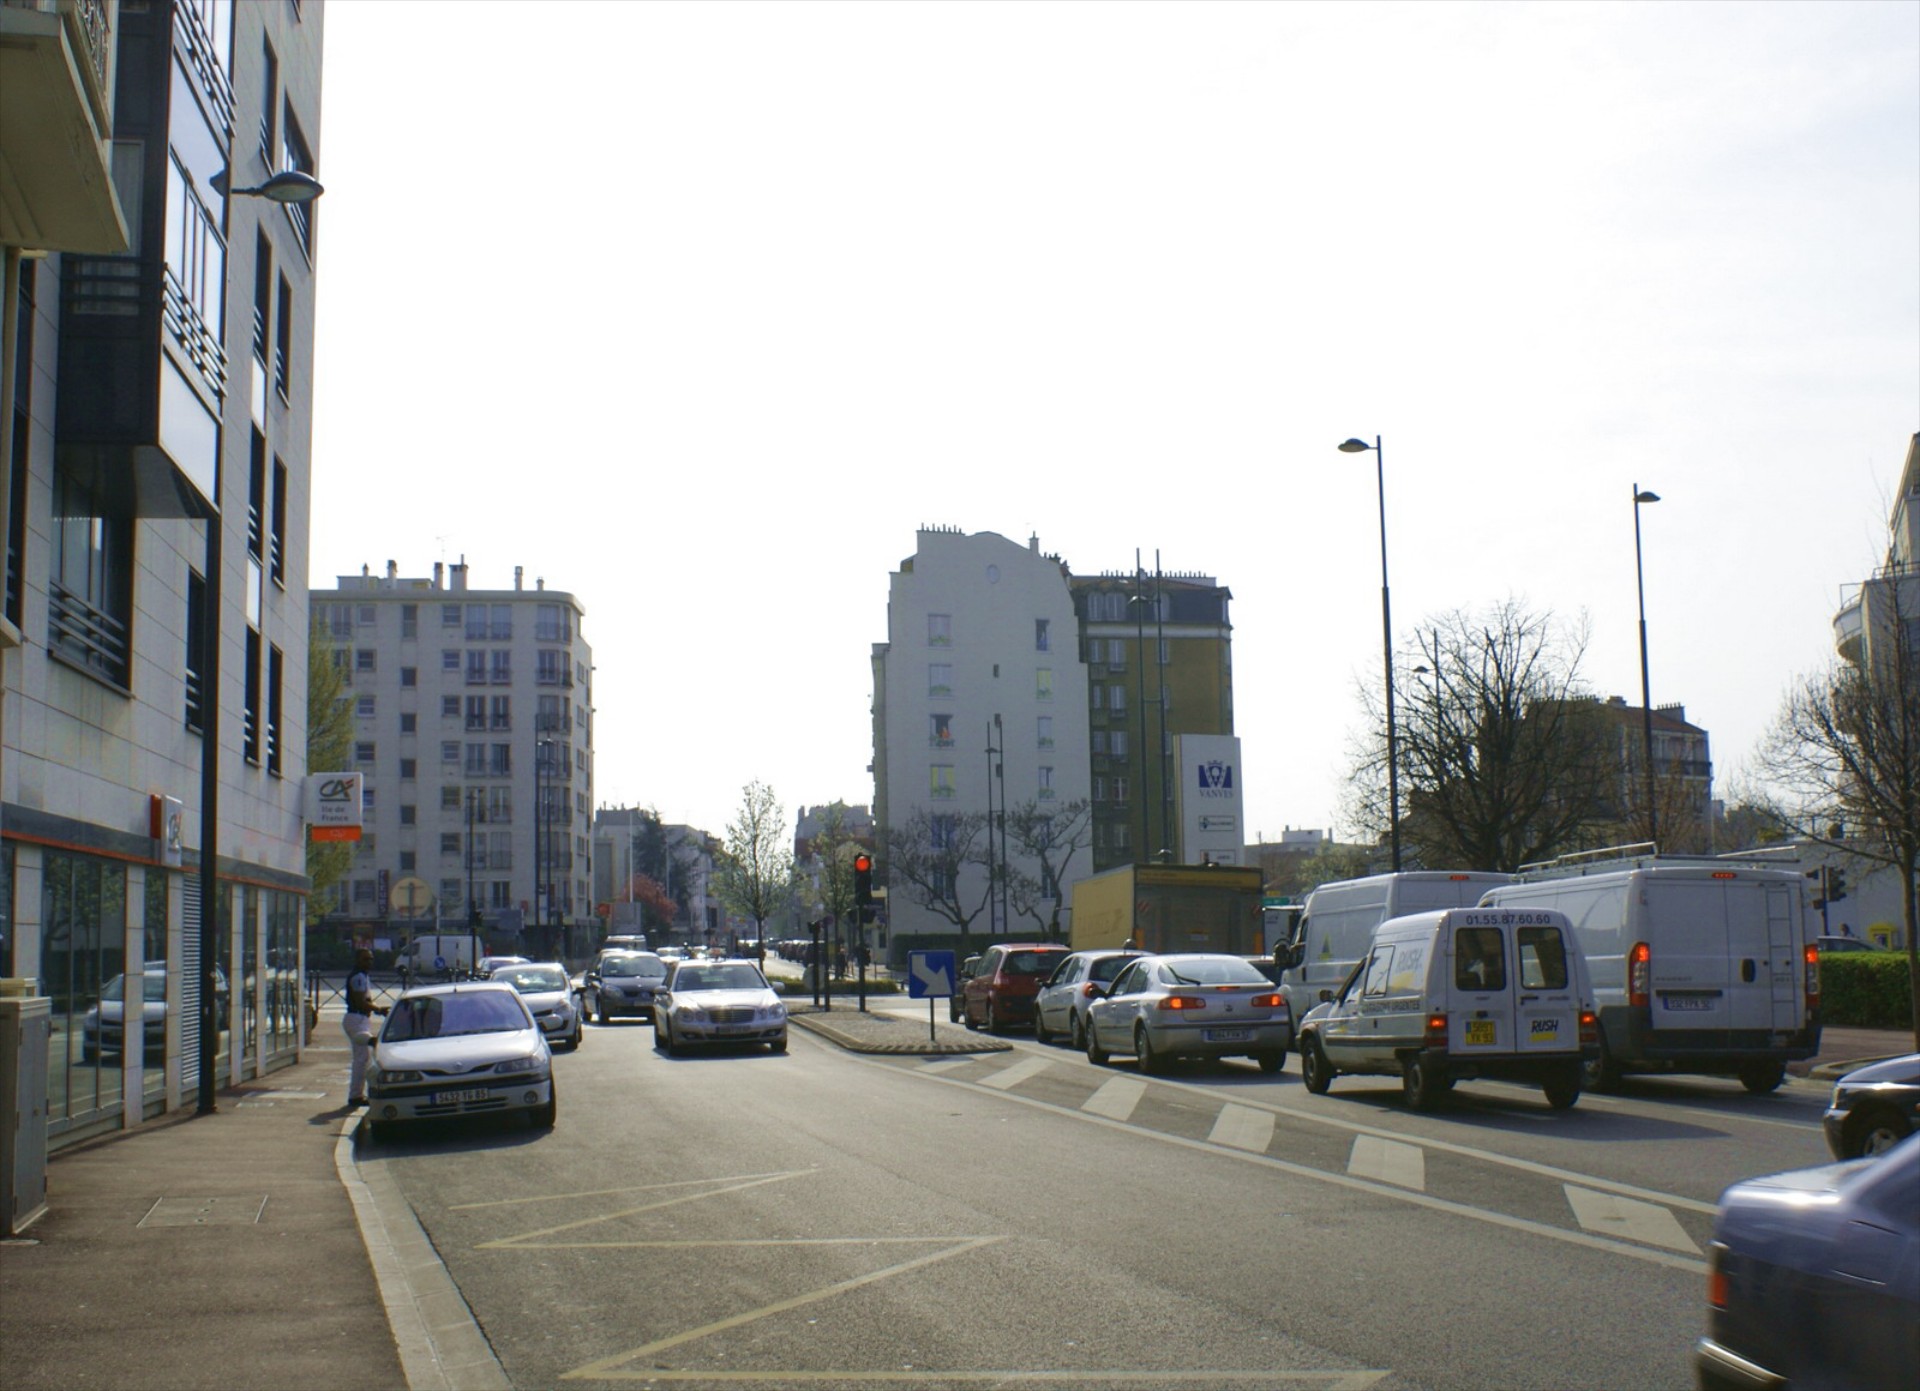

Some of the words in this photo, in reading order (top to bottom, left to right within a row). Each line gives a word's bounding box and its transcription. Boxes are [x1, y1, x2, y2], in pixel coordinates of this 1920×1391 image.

[1200, 789, 1234, 799] VANVES
[321, 813, 349, 821] France
[1466, 914, 1551, 925] 01.55.87.60.60
[1532, 1020, 1558, 1033] RUSH
